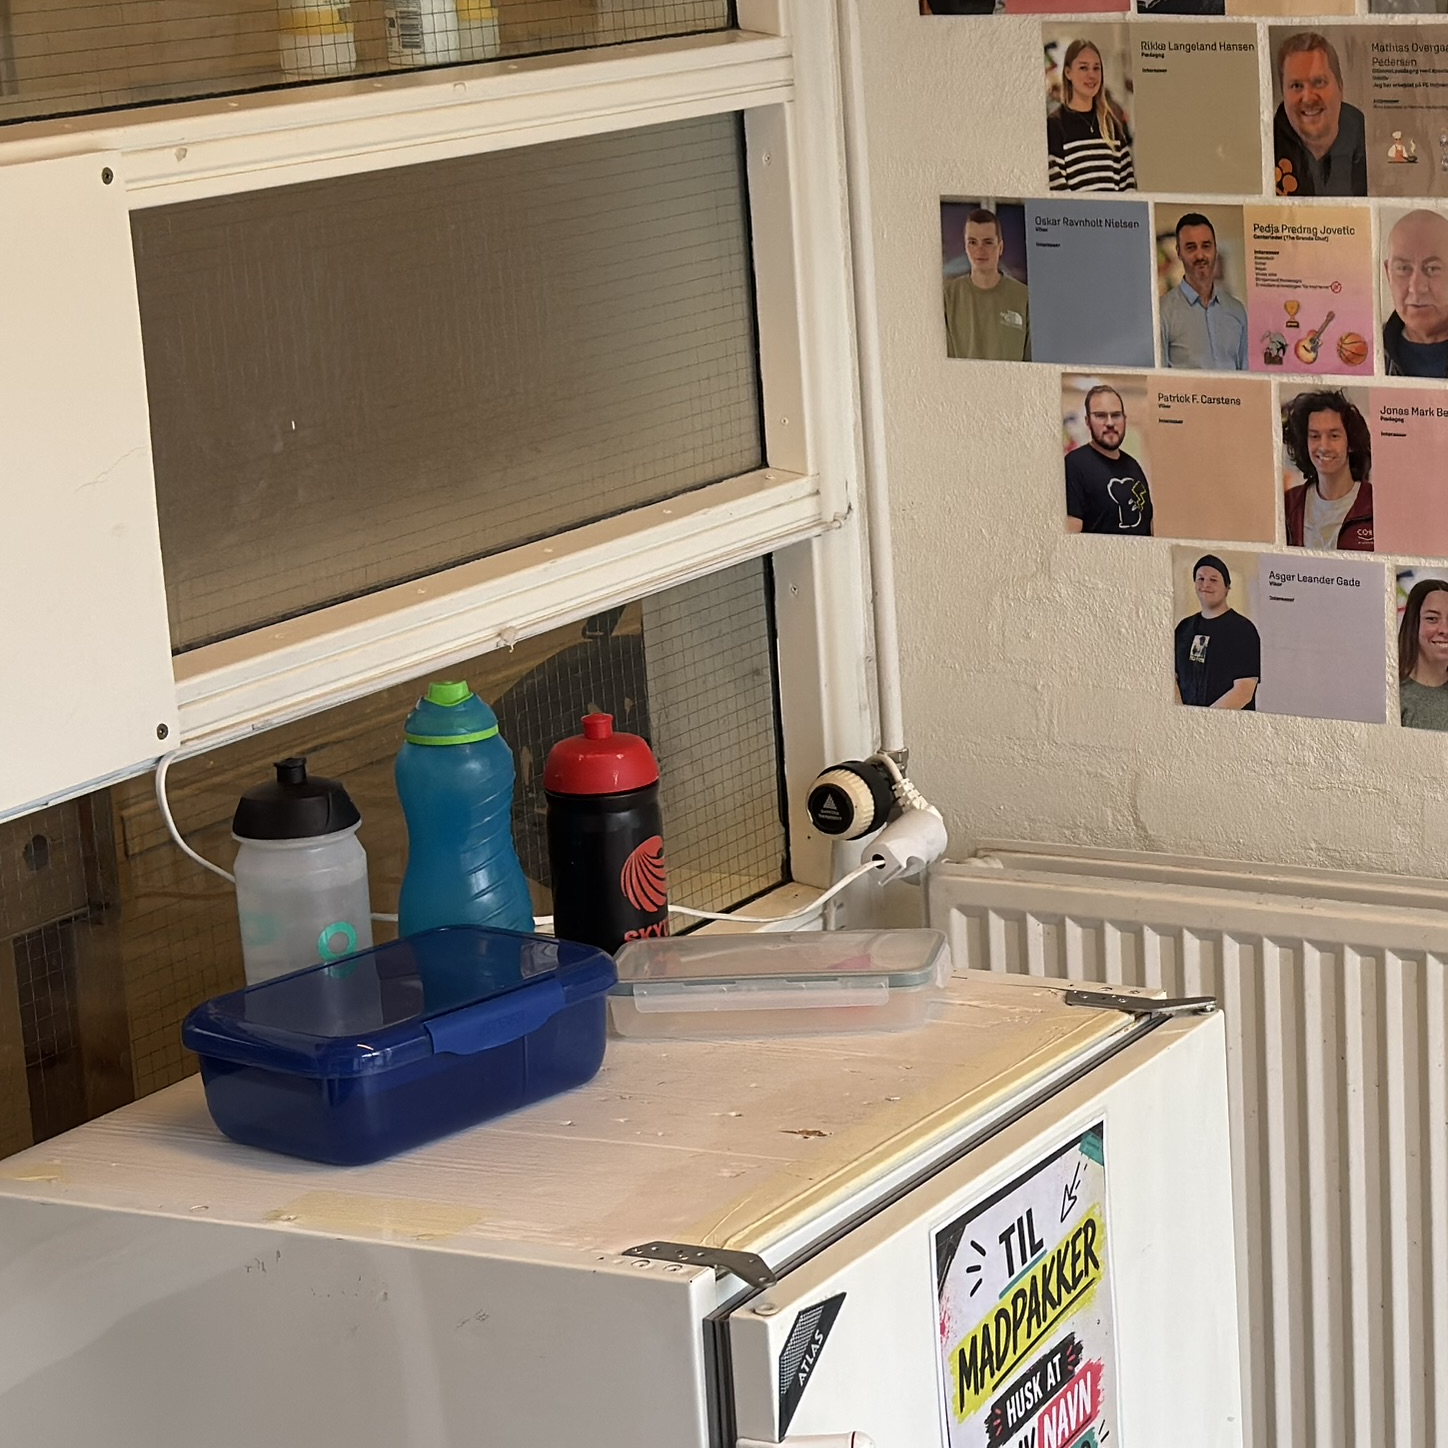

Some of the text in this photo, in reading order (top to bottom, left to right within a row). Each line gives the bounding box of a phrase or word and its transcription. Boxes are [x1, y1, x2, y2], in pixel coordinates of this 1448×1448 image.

[1141, 41, 1254, 53] Rikke Langeland Hansen
[1372, 43, 1409, 53] Mathias
[1373, 57, 1417, 67] Pedersen
[1035, 216, 1139, 228] Oskar Ravnholt Nielsen
[1253, 224, 1279, 234] Pedja
[1281, 225, 1317, 236] Predrag
[1158, 393, 1241, 405] Patrick F. Carstens
[1381, 406, 1409, 416] Jonas
[1411, 407, 1434, 417] Mark
[1269, 571, 1360, 587] Asger Leander Gade
[999, 1208, 1044, 1280] TIL
[956, 1217, 1100, 1413] MADPAKKER
[798, 1329, 824, 1386] ATLAS
[1005, 1352, 1065, 1429] HUSK AT
